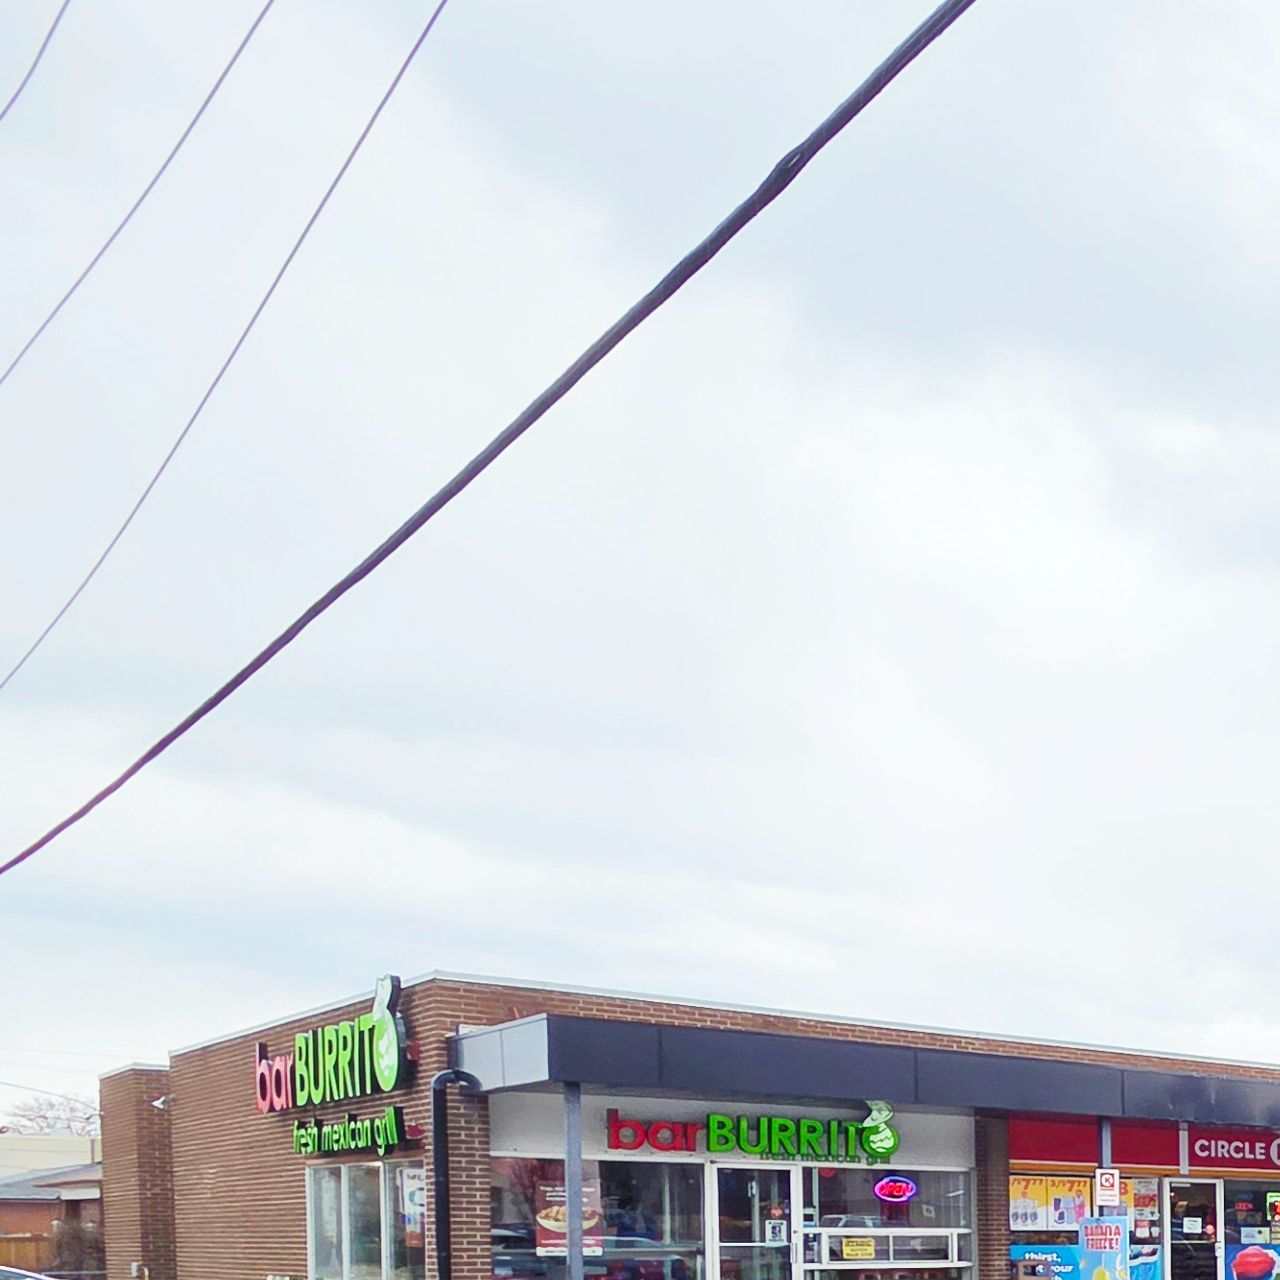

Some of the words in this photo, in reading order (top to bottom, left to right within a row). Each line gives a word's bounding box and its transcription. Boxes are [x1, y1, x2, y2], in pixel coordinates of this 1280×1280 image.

[293, 1118, 319, 1154] fresh
[321, 1112, 373, 1152] mexican
[373, 1105, 399, 1157] grill
[1194, 1138, 1266, 1160] CIRCLE
[879, 1181, 912, 1196] OPEN
